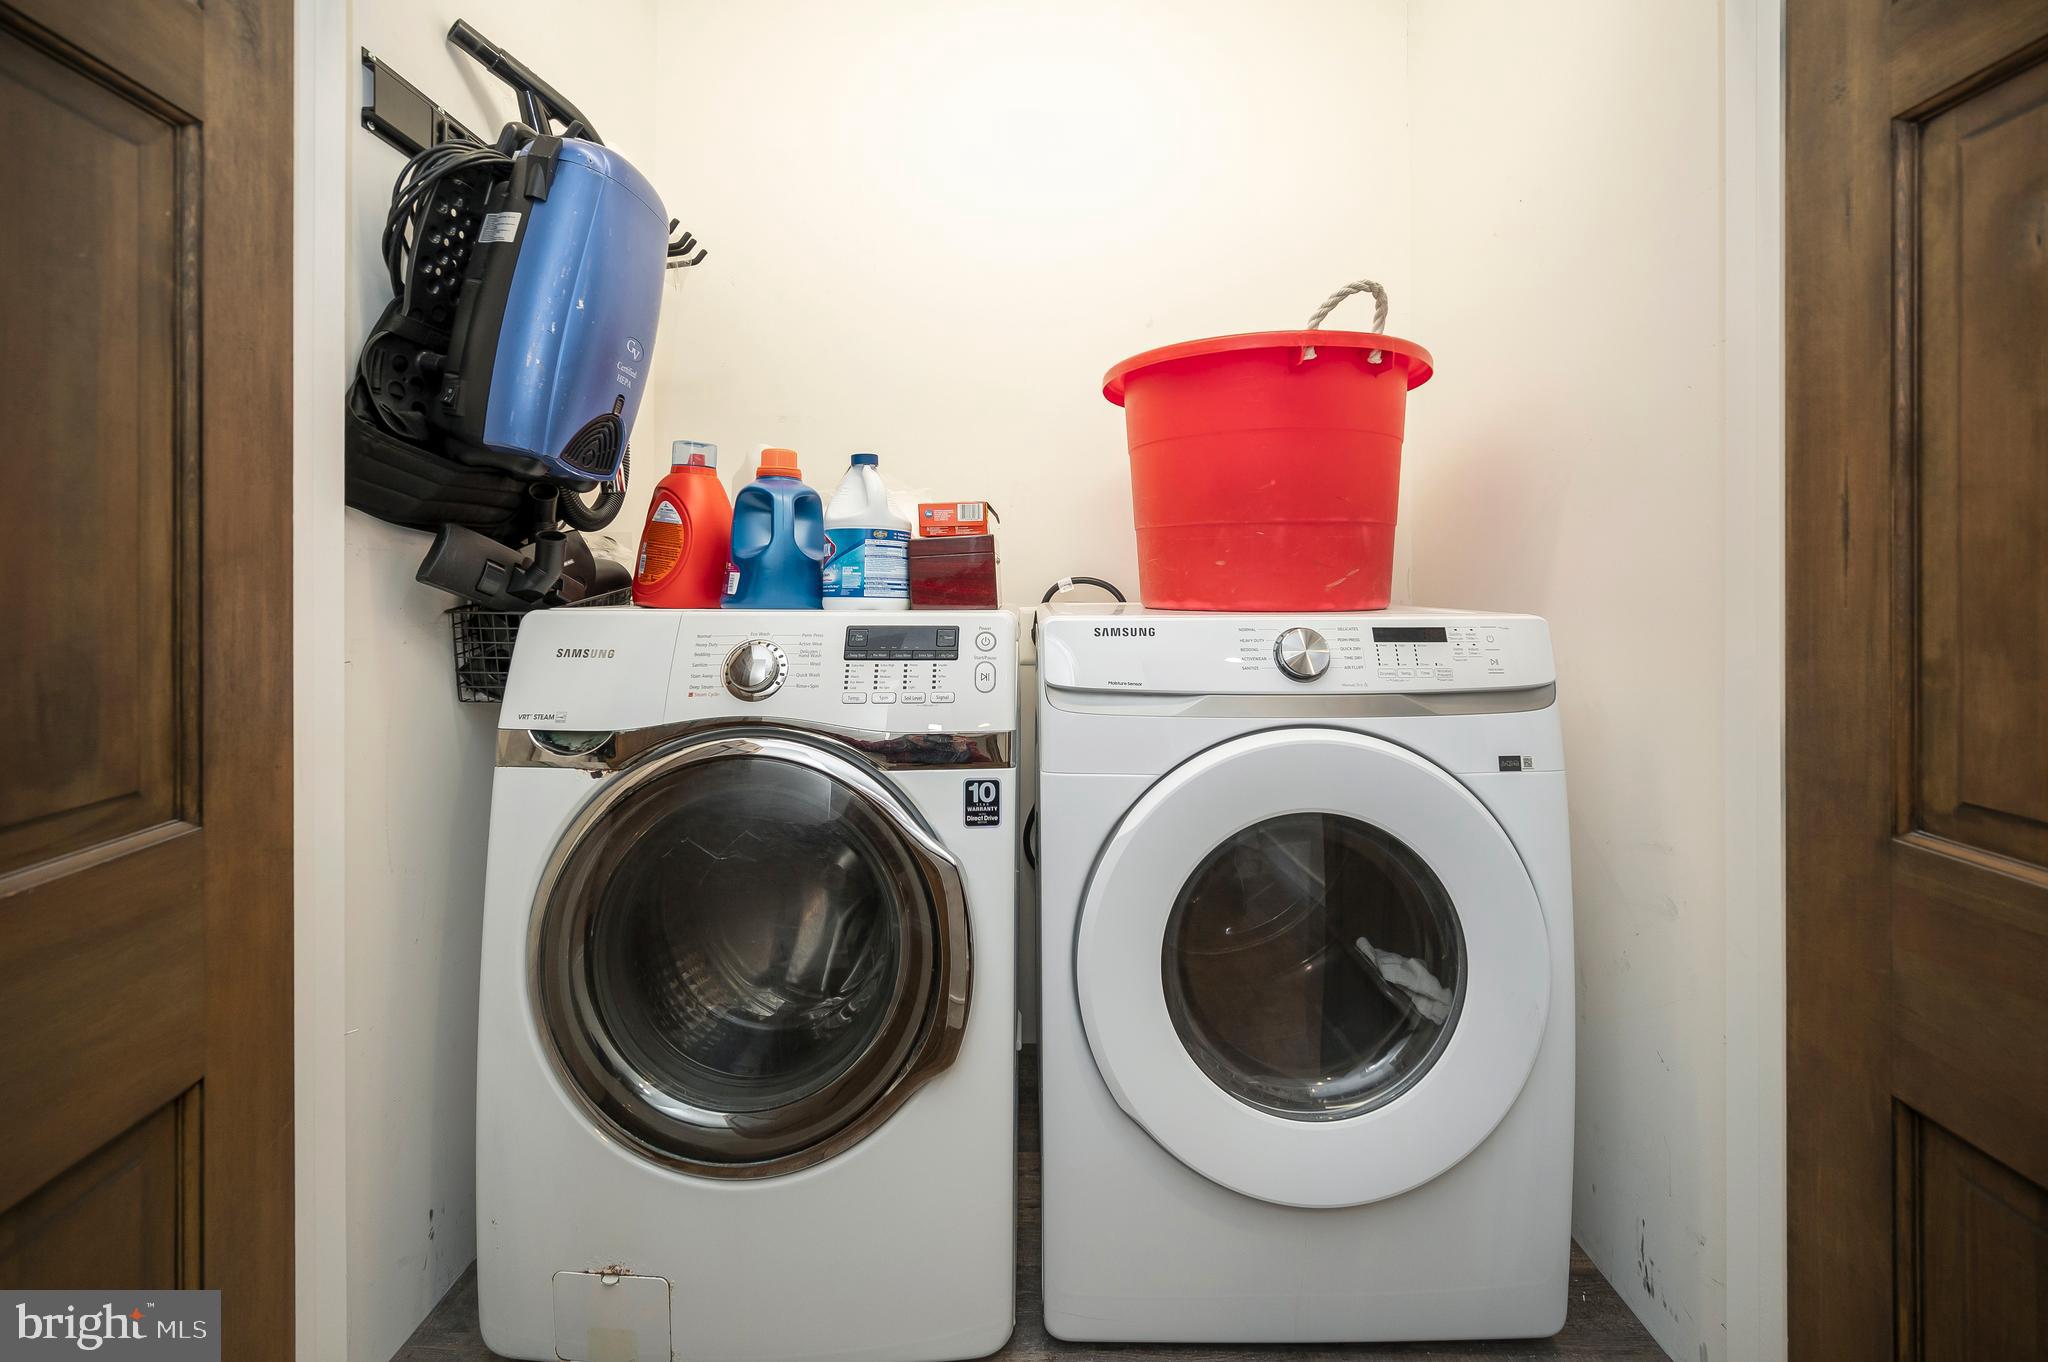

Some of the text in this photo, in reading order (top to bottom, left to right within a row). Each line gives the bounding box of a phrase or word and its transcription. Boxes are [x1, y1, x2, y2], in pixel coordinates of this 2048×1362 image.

[616, 361, 638, 379] Certified
[616, 374, 632, 389] HEPA
[1094, 627, 1156, 637] SAMSUNG
[556, 648, 616, 659] SAMSUNG
[533, 713, 555, 721] STEAM
[968, 781, 996, 803] 10
